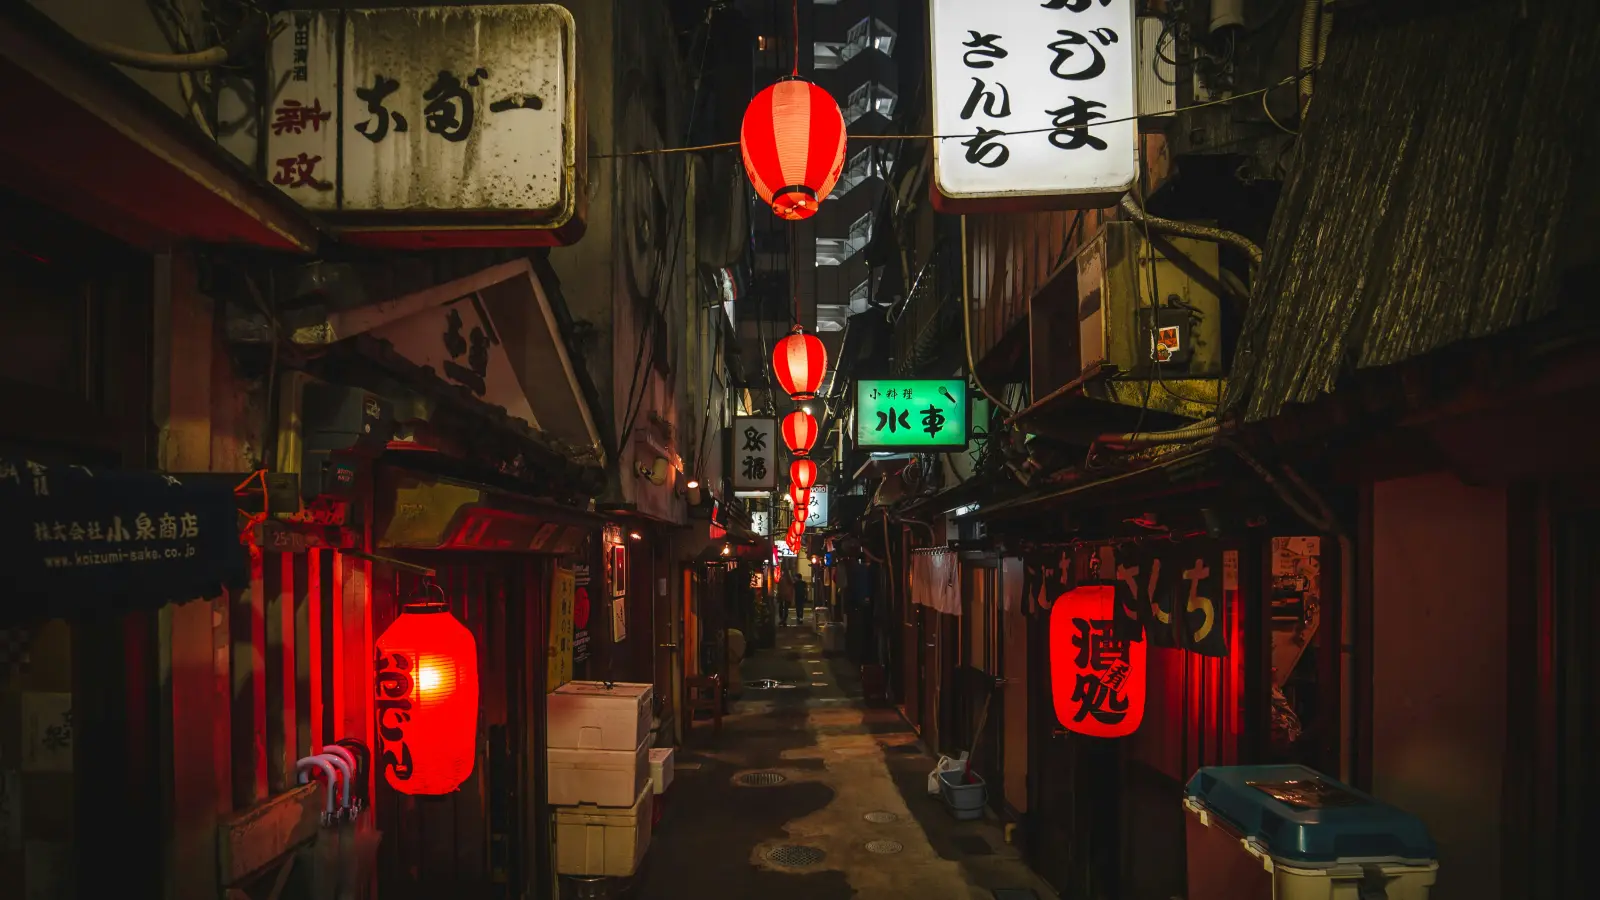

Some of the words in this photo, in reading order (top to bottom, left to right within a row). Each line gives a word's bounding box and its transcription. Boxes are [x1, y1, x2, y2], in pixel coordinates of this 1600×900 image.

[960, 30, 1011, 168] さんち
[869, 388, 913, 400] 小料理
[875, 403, 946, 439] 水車
